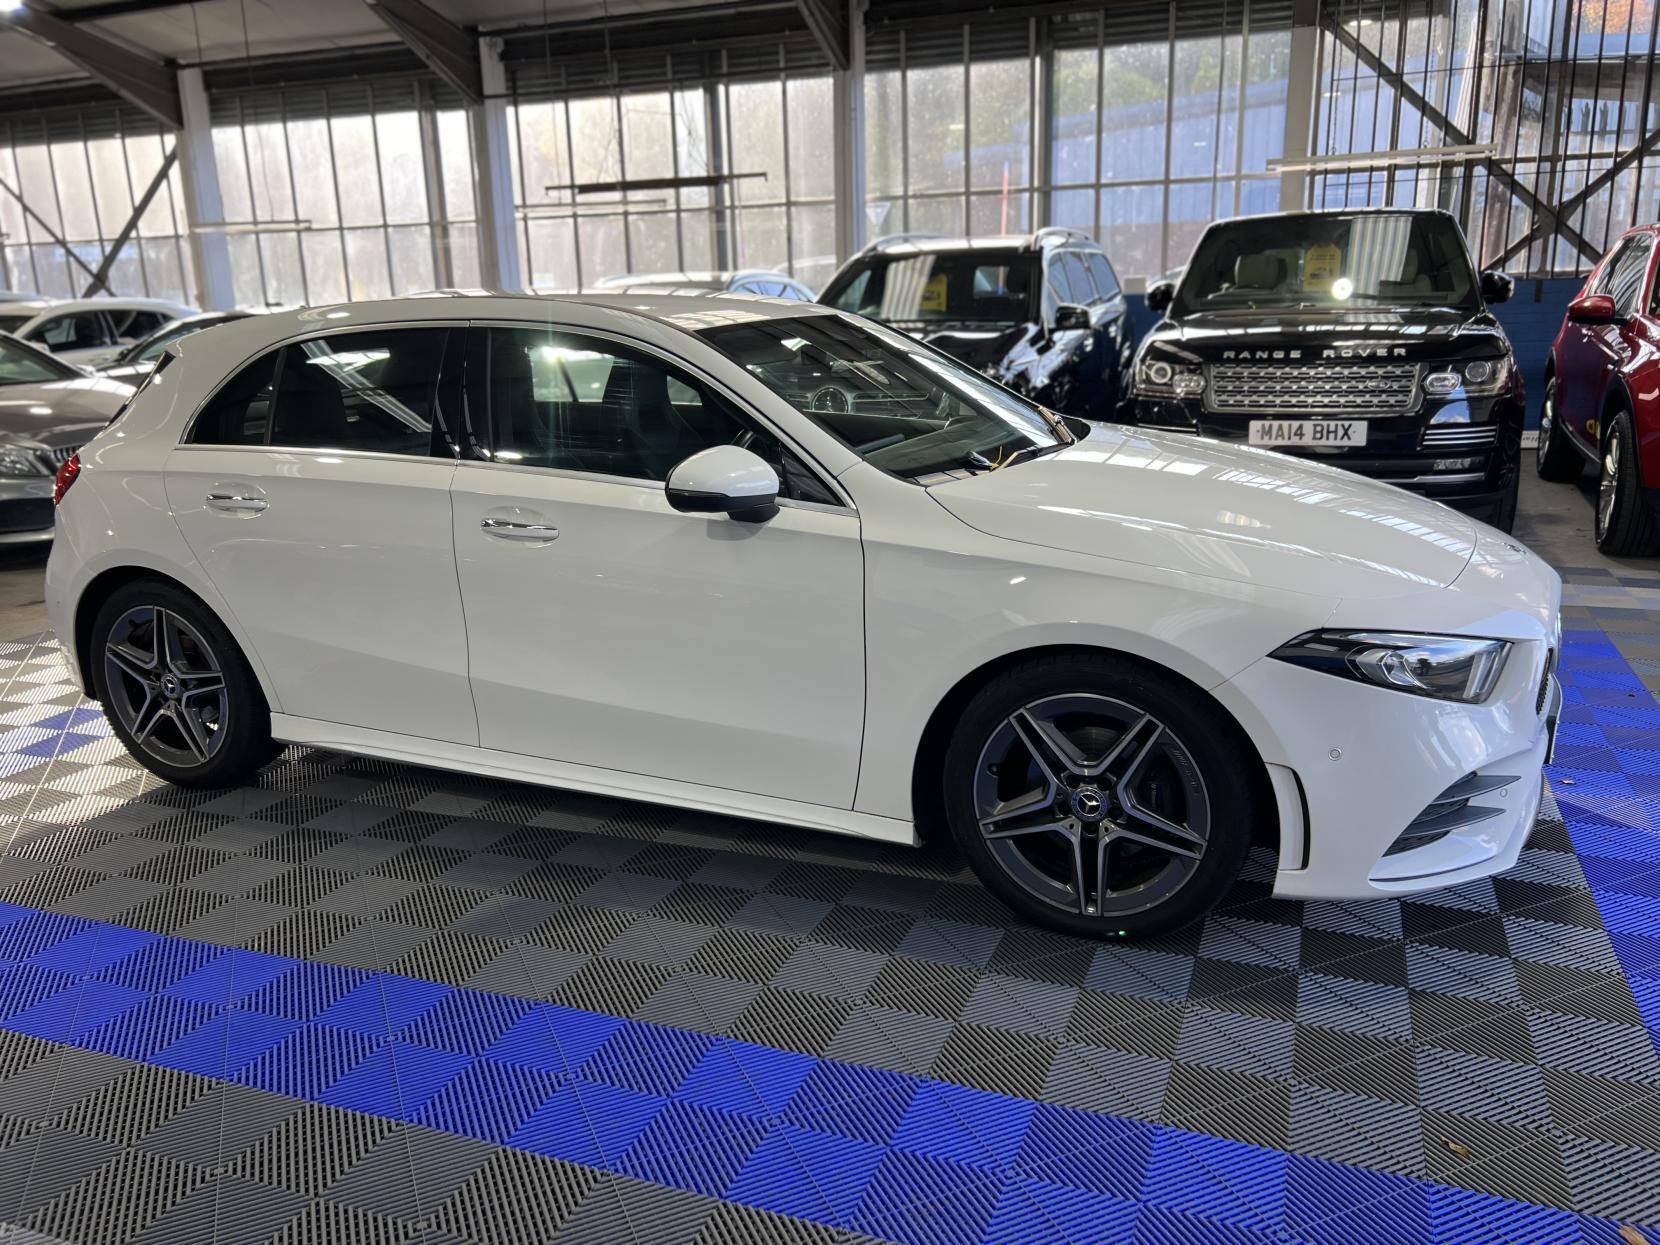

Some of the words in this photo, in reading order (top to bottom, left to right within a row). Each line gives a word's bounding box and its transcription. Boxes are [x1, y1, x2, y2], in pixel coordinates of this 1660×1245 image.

[1223, 349, 1302, 359] RANGE
[1322, 347, 1407, 358] ROVER
[1260, 423, 1305, 441] MA14
[1311, 423, 1353, 441] BHX
